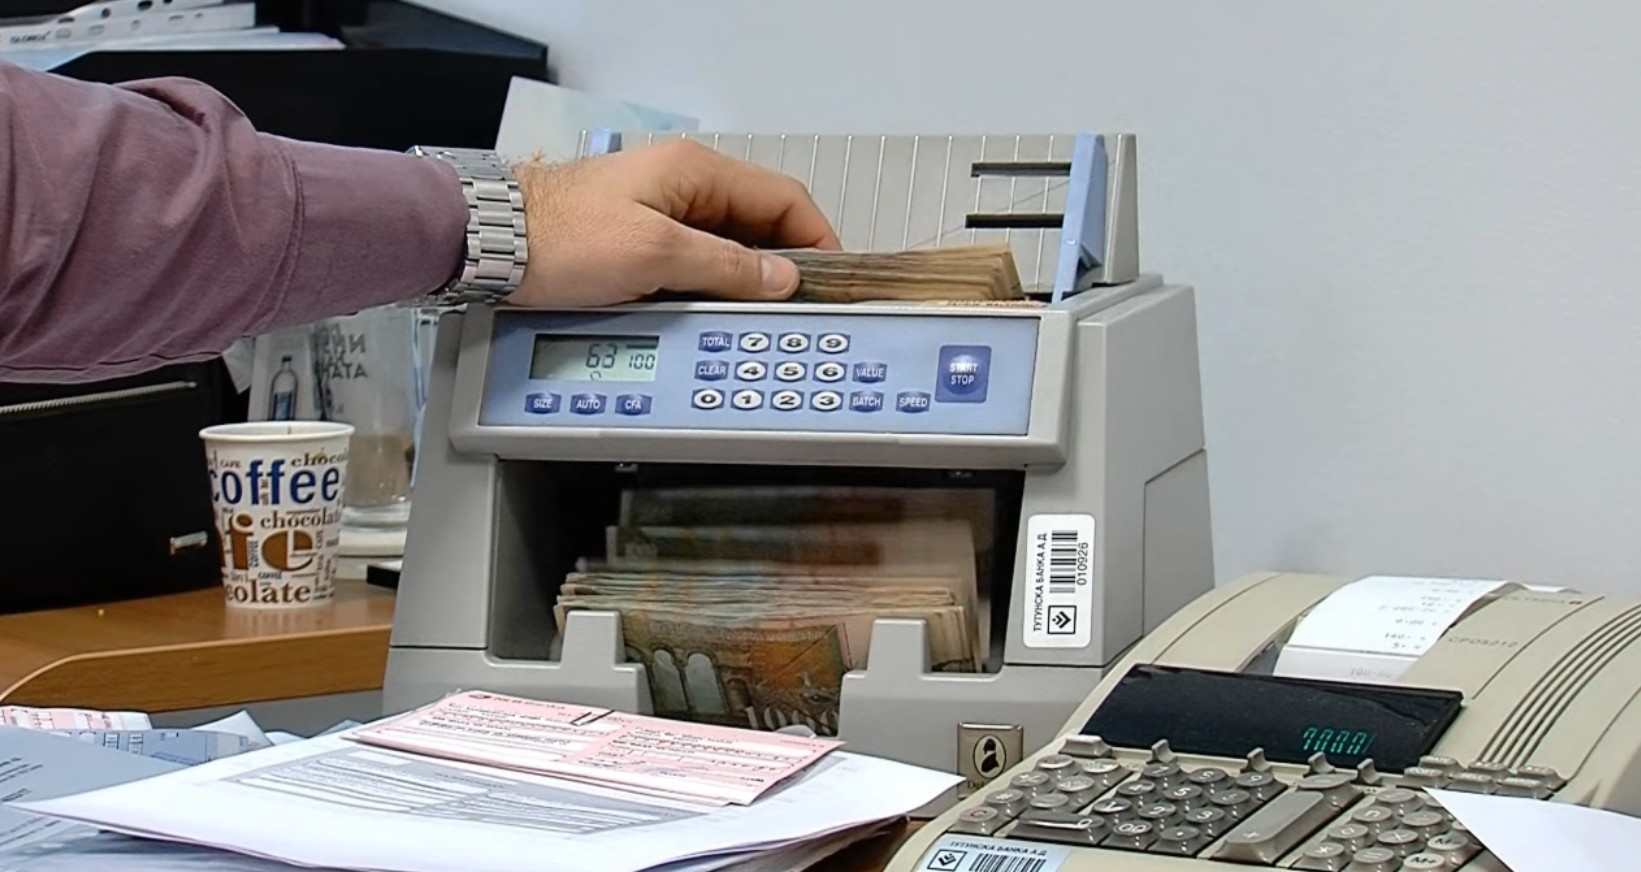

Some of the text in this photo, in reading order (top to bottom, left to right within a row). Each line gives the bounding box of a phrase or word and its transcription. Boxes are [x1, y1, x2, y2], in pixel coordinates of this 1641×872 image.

[702, 336, 841, 349] TOTAL 7 8 9
[629, 354, 656, 370] 100
[950, 362, 978, 374] START
[698, 365, 883, 378] CLEAR 4 5 6 VALUE
[951, 375, 974, 385] STOP
[534, 399, 641, 410] SIZE AUTO CFA
[780, 396, 795, 405] 2
[819, 396, 834, 406] 3
[852, 397, 881, 408] BATCH
[900, 398, 927, 408] SPEED
[1036, 552, 1046, 583] БАНКА
[1077, 542, 1089, 586] 010926
[1033, 585, 1044, 632] ТУТУНСКА
[1119, 823, 1147, 834] 00
